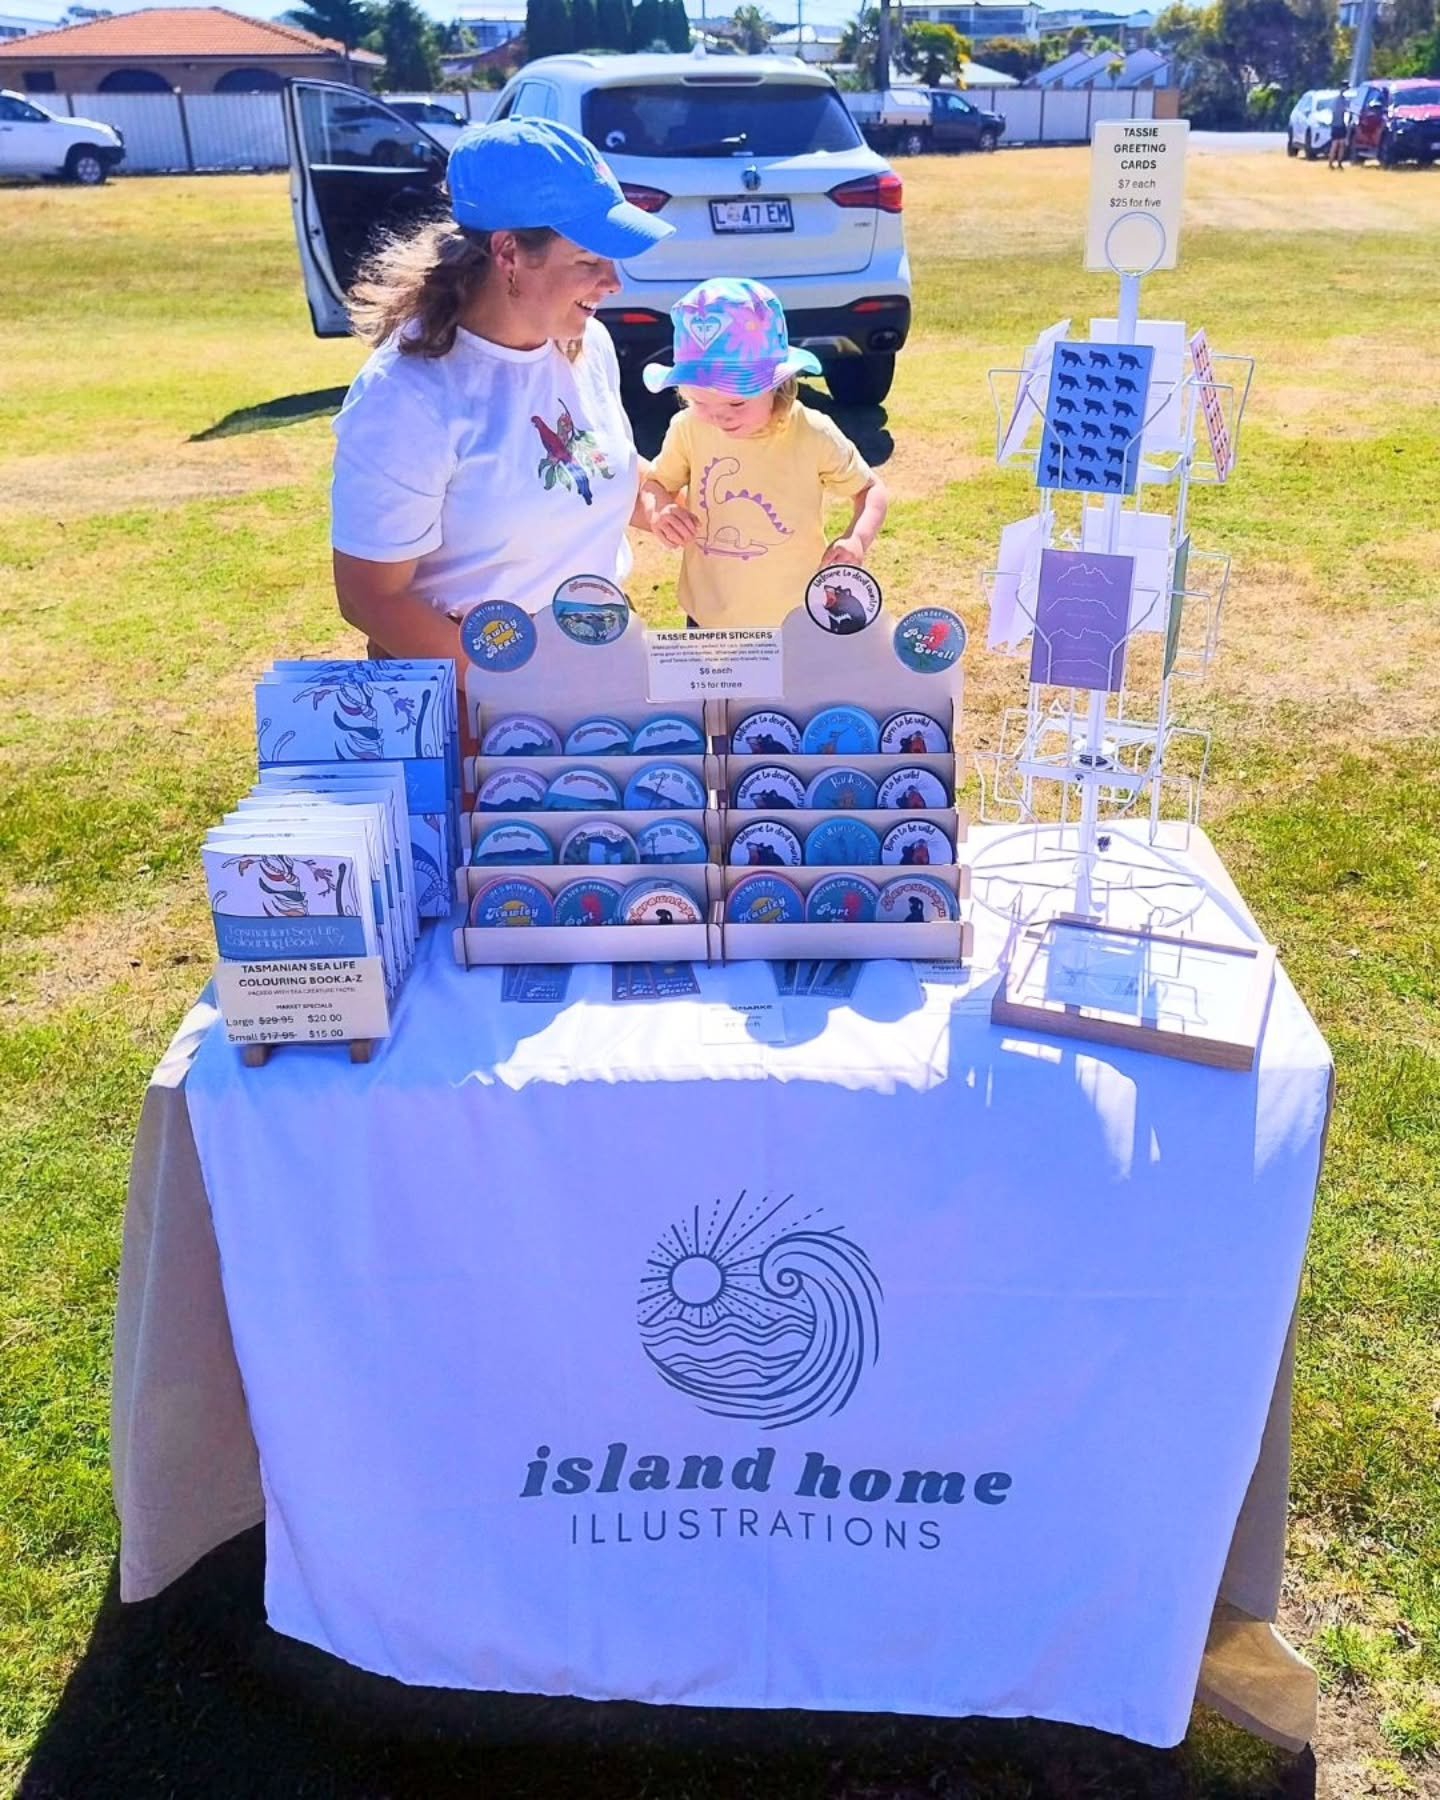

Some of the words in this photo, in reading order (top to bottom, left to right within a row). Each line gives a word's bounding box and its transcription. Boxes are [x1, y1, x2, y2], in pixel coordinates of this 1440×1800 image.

[1123, 128, 1159, 137] TASSIE
[1113, 143, 1167, 153] GREETING
[1120, 160, 1157, 169] CARDS
[1117, 179, 1130, 189] $7
[1132, 179, 1156, 189] each
[1109, 198, 1127, 208] $25
[1129, 198, 1142, 207] for
[1144, 198, 1161, 207] five
[742, 204, 760, 224] 47
[656, 633, 688, 641] TASSIE
[689, 632, 728, 640] BUMPER
[729, 631, 773, 640] STICKERS
[712, 667, 733, 675] each
[690, 681, 706, 690] $15
[707, 681, 719, 689] for
[720, 681, 742, 689] three
[241, 963, 307, 974] TASMANIAN
[310, 962, 331, 971] SEA
[333, 960, 356, 970] LIFE
[239, 976, 307, 988] COLOURING
[226, 1018, 254, 1027] Large
[228, 1033, 257, 1042] Small
[519, 1442, 777, 1498] island
[794, 1451, 1013, 1505] home
[571, 1507, 942, 1550] ILLUSTRATIONS
